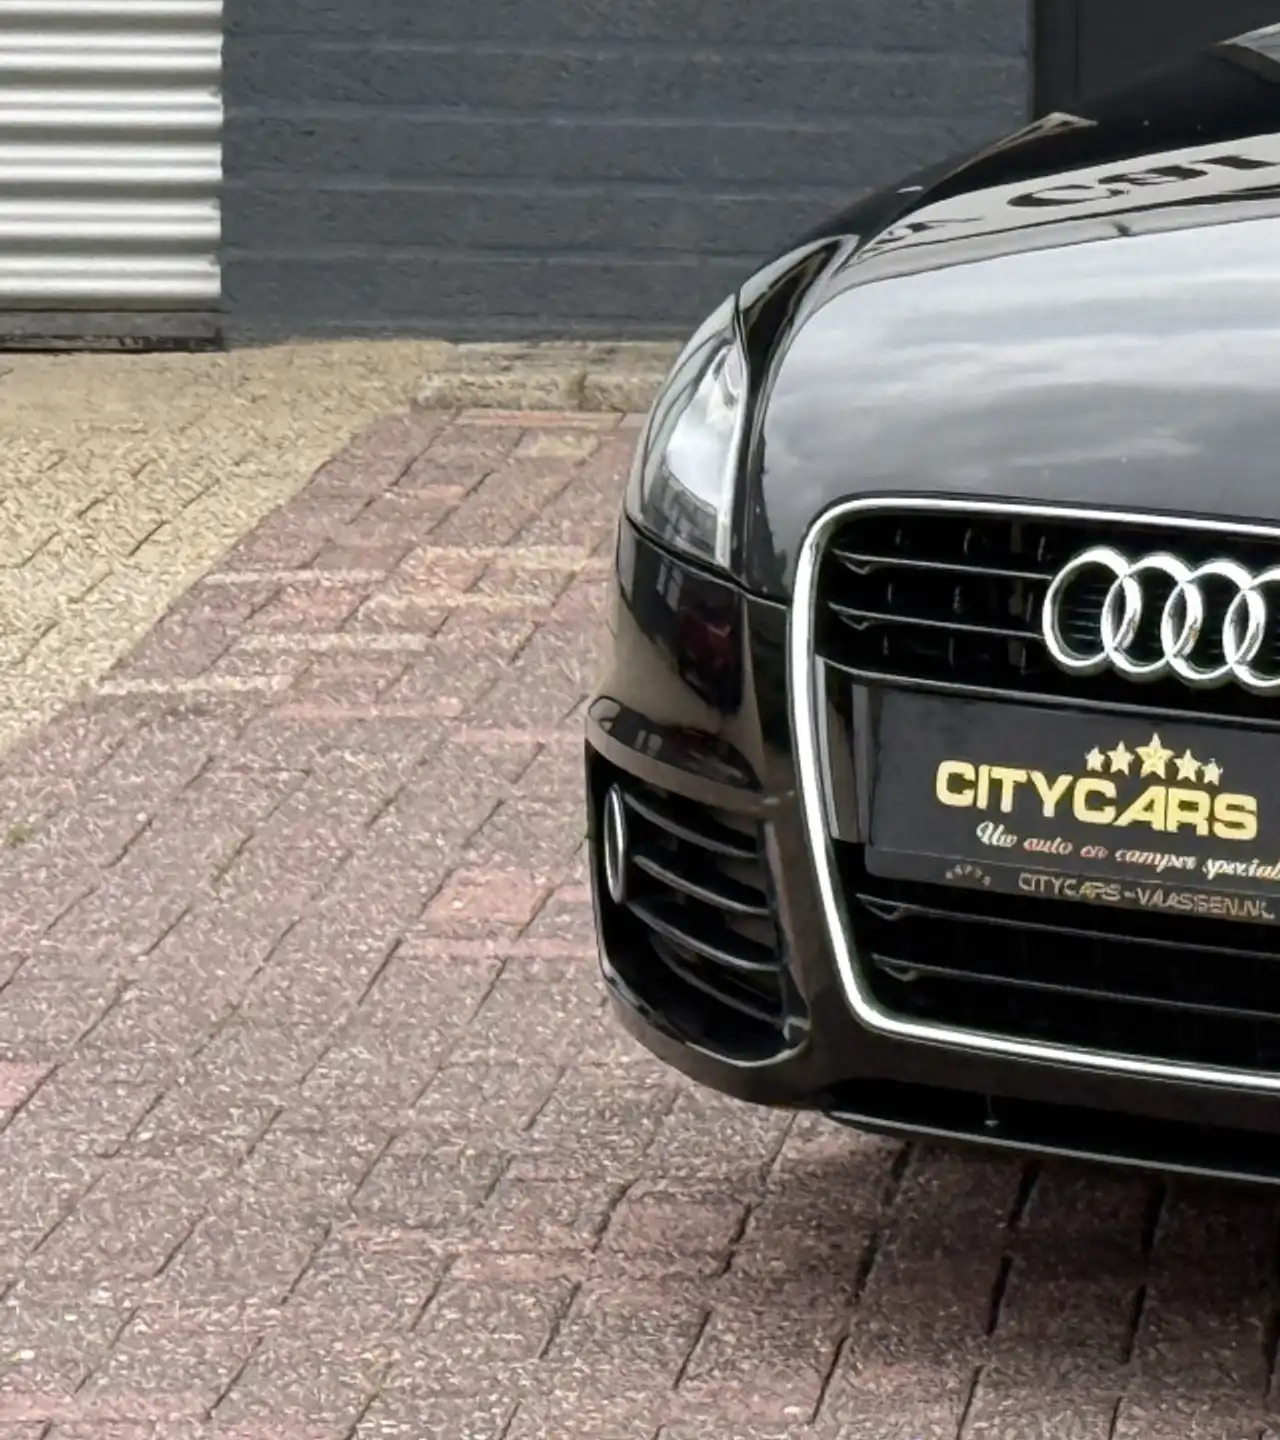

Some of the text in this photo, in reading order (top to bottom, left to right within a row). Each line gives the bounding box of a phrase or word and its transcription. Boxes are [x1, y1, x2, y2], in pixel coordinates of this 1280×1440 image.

[935, 759, 1259, 841] CITYCARS
[975, 820, 1018, 849] Uw
[1023, 836, 1074, 857] auto
[1080, 844, 1110, 859] en
[1114, 848, 1198, 874] camper
